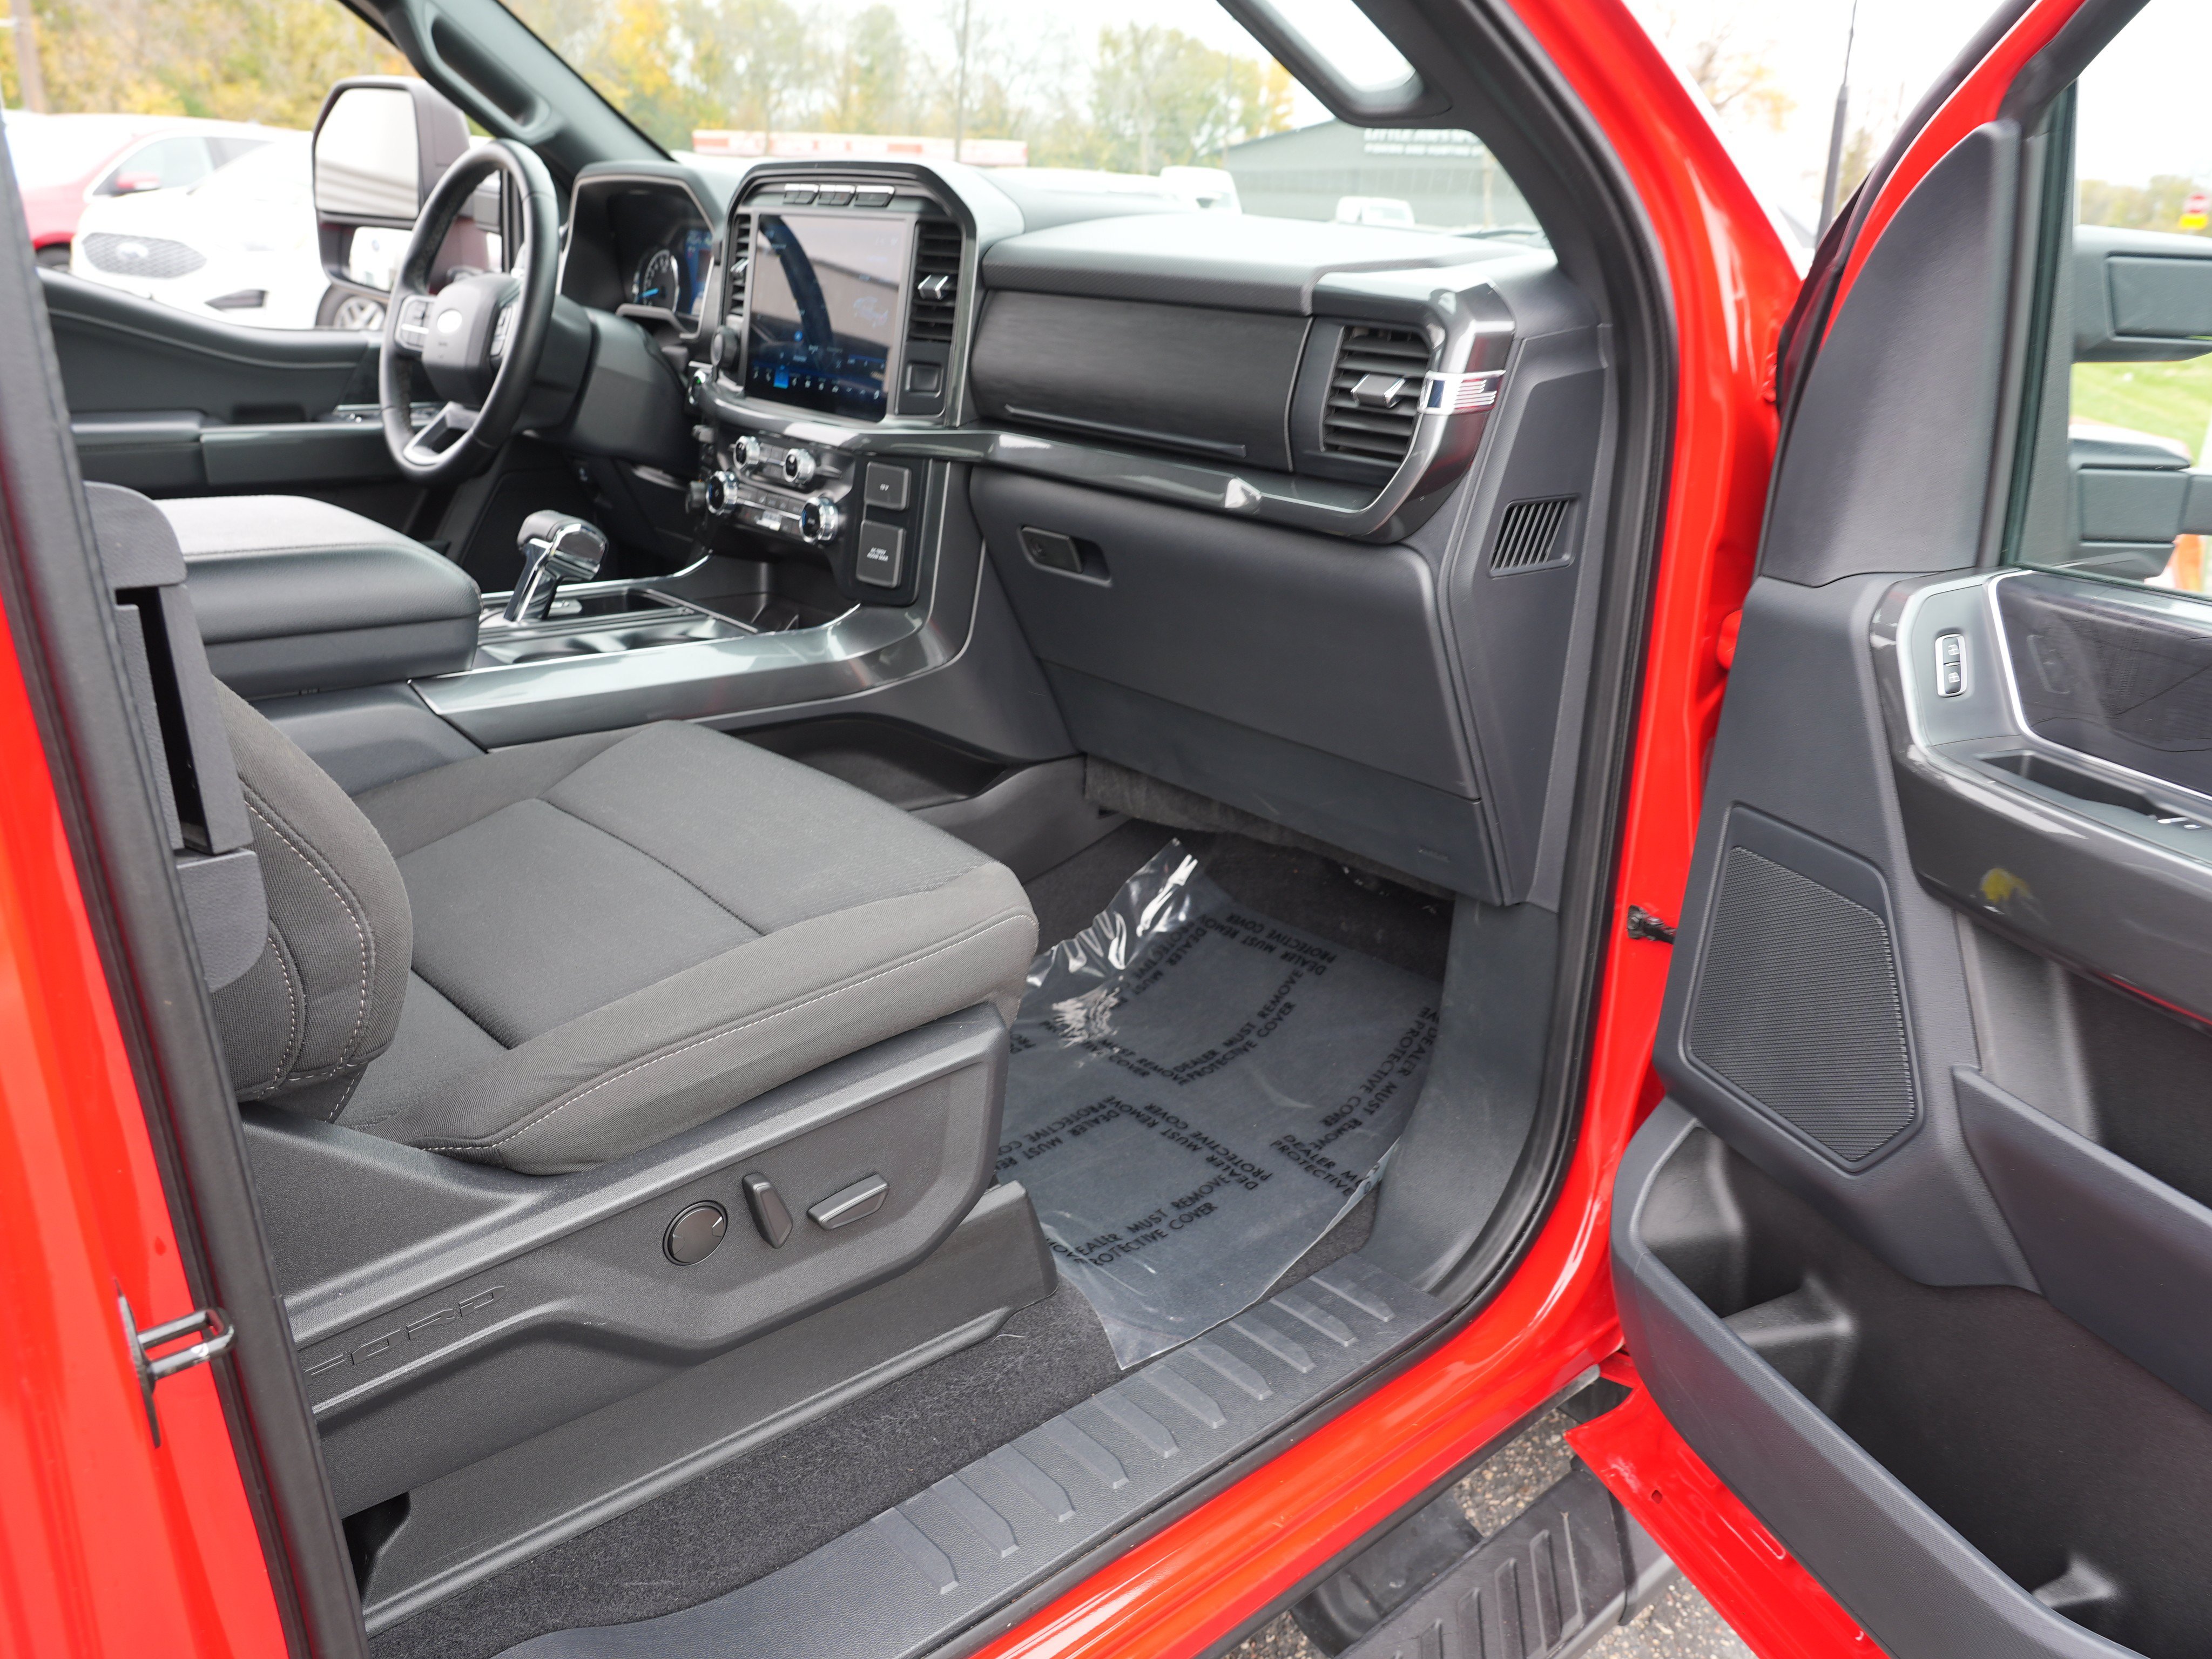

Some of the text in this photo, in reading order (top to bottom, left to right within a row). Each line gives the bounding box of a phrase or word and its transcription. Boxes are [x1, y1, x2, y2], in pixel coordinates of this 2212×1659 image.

[1166, 927, 1206, 966] DEALER
[1226, 913, 1337, 963] PROTECTIVE COVER
[1241, 936, 1277, 954] MUST
[1132, 970, 1164, 995] MUST
[1280, 950, 1327, 975] DEALER
[1173, 969, 1304, 1073] DEALER MUST REMOVE
[1186, 1001, 1296, 1081] PROTECTIVE COVER
[1108, 1055, 1151, 1077] COVER
[1397, 1026, 1438, 1076] DEALER
[1136, 1058, 1190, 1086] REMOVE
[1319, 1020, 1426, 1126] PROTECTIVE COVER
[1363, 1081, 1398, 1116] MUST
[1026, 1102, 1107, 1143] PROTECTIVE
[1067, 1110, 1121, 1136] DEALER
[1103, 1095, 1259, 1190] DEALER MUST REMOVE
[1144, 1103, 1273, 1182] PROTECTIVE COVER
[1309, 1117, 1363, 1150] REMOVE
[1024, 1136, 1064, 1160] MUST
[1270, 1139, 1354, 1197] PROTECTIVE
[1283, 1134, 1337, 1169] DEALER
[1075, 1233, 1124, 1256] EALER
[1126, 1208, 1169, 1235] MUST
[1171, 1174, 1231, 1210] REMOVE
[1089, 1228, 1169, 1266] ROTECTIVE
[1169, 1202, 1219, 1231] COVER
